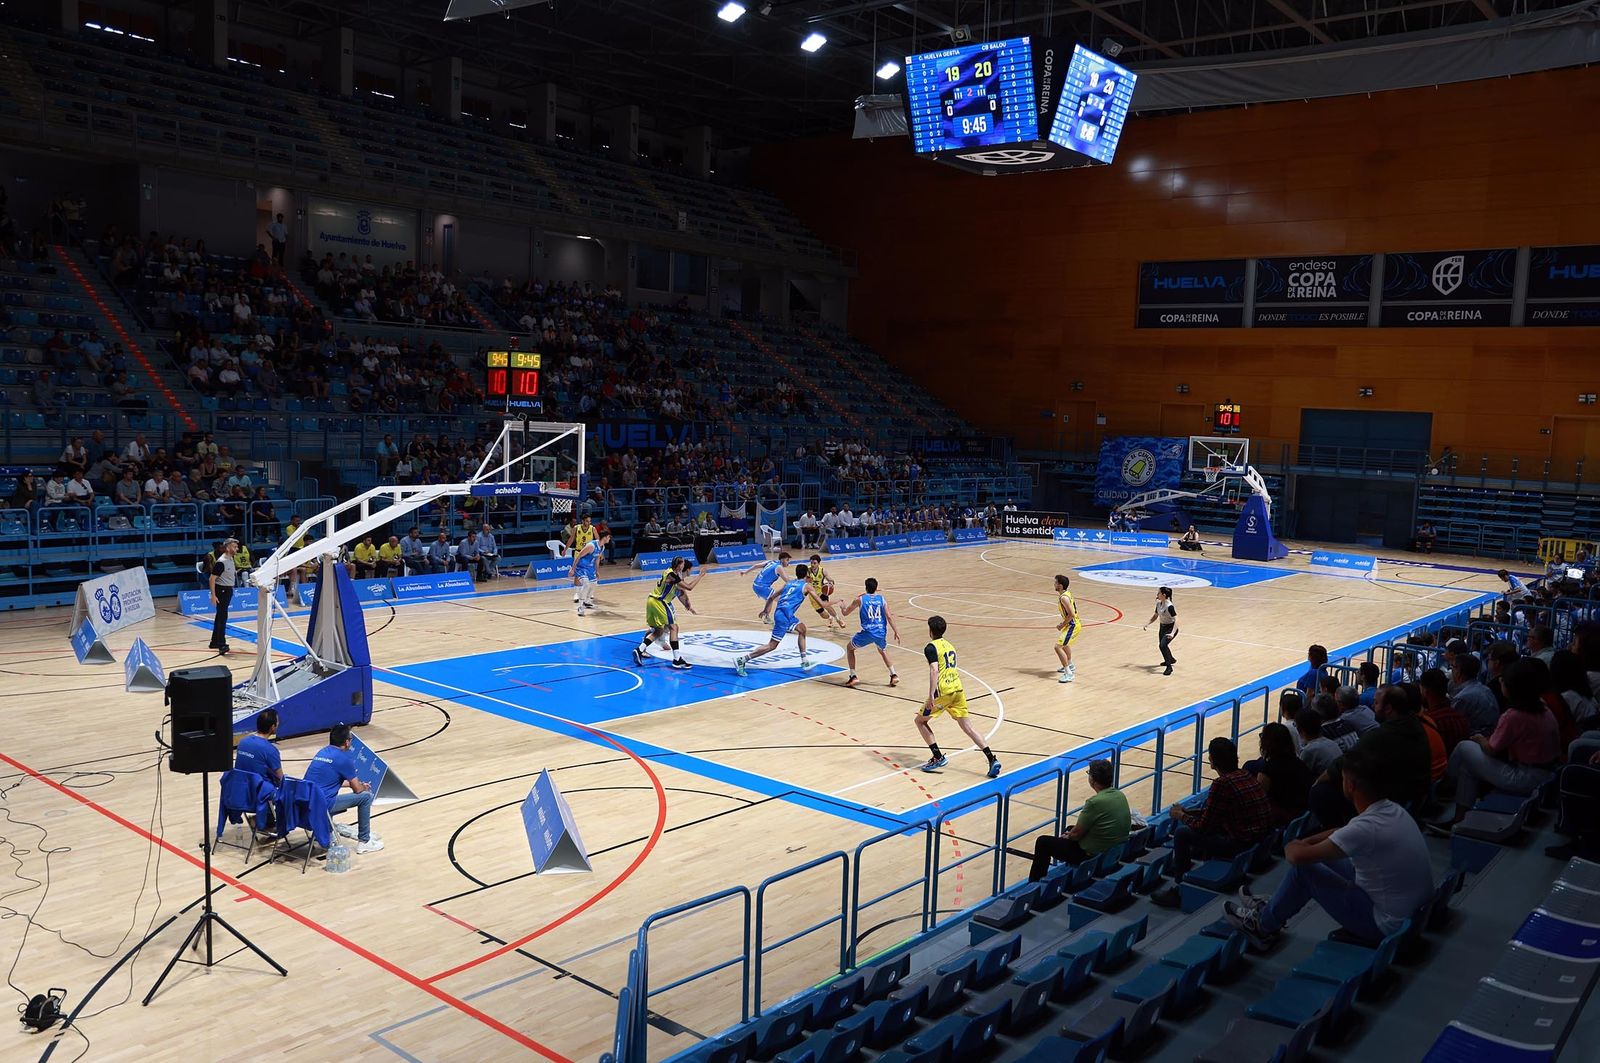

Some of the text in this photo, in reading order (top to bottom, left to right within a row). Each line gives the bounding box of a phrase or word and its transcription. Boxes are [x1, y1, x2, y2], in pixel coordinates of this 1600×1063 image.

[1044, 49, 1054, 77] COPA
[945, 61, 992, 82] 19 20
[967, 88, 972, 96] 2
[1040, 84, 1050, 114] REINA
[947, 100, 996, 116] 0 0
[962, 116, 986, 134] 9:45
[320, 232, 407, 251] Ayuntamiento de Huelva
[1289, 260, 1336, 270] endesa
[1154, 275, 1226, 289] HUELVA
[1288, 272, 1336, 287] COPA
[1297, 286, 1337, 298] REINA
[1160, 314, 1185, 322] COPA
[1192, 313, 1219, 323] REINA
[1330, 312, 1365, 321] POSIBLE
[1407, 311, 1439, 320] COPA
[1447, 310, 1482, 320] REINA
[1532, 310, 1570, 319] DONDE
[518, 354, 540, 368] 9:45
[494, 370, 537, 395] 10 10
[1220, 413, 1231, 424] 10
[1098, 490, 1128, 499] CIUDAD
[1005, 515, 1065, 526] Huelva eleva
[868, 604, 881, 622] 44
[944, 651, 957, 669] 13
